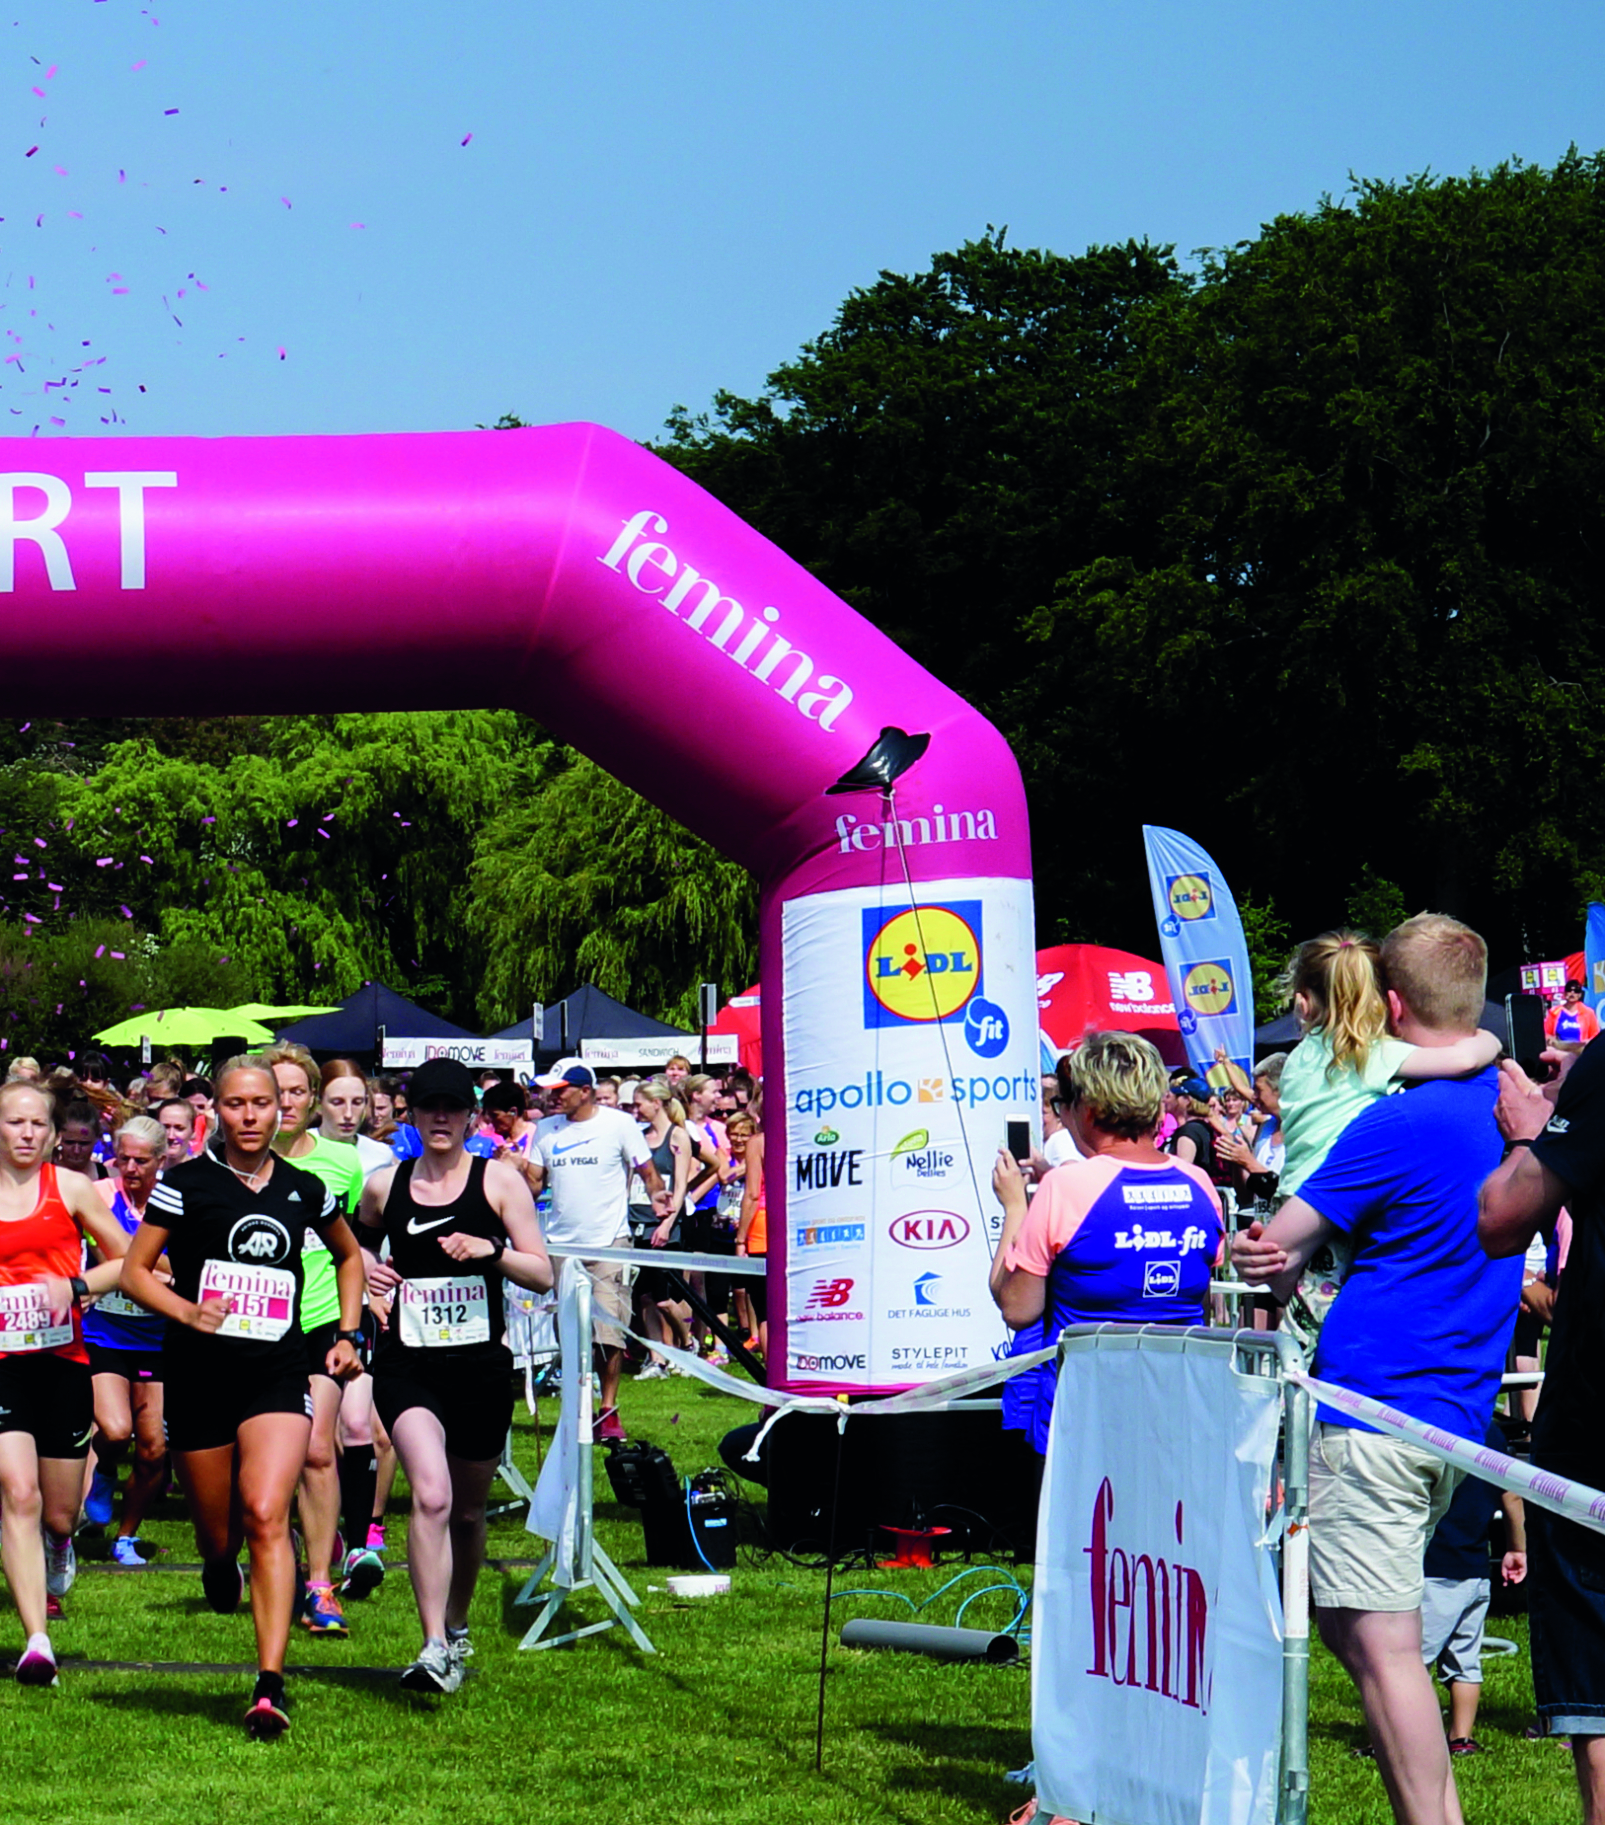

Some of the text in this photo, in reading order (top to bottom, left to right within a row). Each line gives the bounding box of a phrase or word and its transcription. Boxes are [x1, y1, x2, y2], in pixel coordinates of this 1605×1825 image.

[596, 509, 856, 733] femina
[835, 804, 998, 854] femina
[975, 1016, 1003, 1046] fit
[795, 1068, 1037, 1118] apollo sports
[552, 1155, 598, 1168] LAS VEGAS
[796, 1150, 863, 1192] MOVE
[906, 1150, 954, 1170] Nellie
[904, 1219, 957, 1241] KIA
[204, 1263, 290, 1297] femina
[400, 1281, 484, 1304] femina
[4, 1311, 51, 1331] 2489
[421, 1304, 468, 1325] 1312
[888, 1308, 971, 1319] DET FAGLIGE HUS
[891, 1347, 968, 1360] STYLEPIT
[1083, 1476, 1218, 1716] femin
